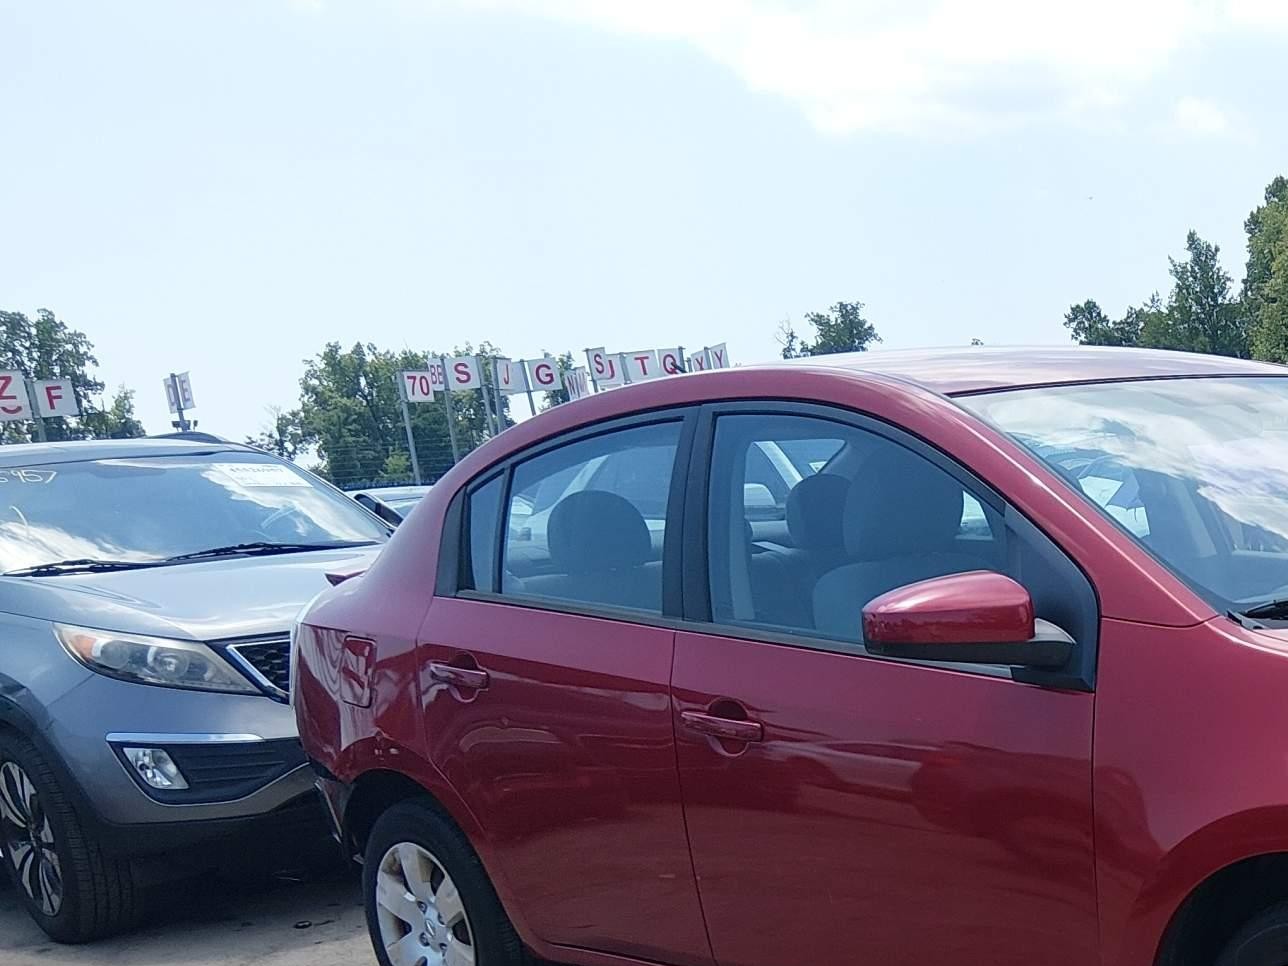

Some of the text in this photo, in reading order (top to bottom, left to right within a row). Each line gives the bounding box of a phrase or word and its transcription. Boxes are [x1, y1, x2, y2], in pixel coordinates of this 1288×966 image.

[453, 362, 472, 384] S
[535, 363, 555, 385] G
[593, 353, 605, 374] S
[634, 356, 649, 376] T
[662, 353, 679, 375] Q
[406, 375, 430, 396] 70
[45, 385, 63, 410] F
